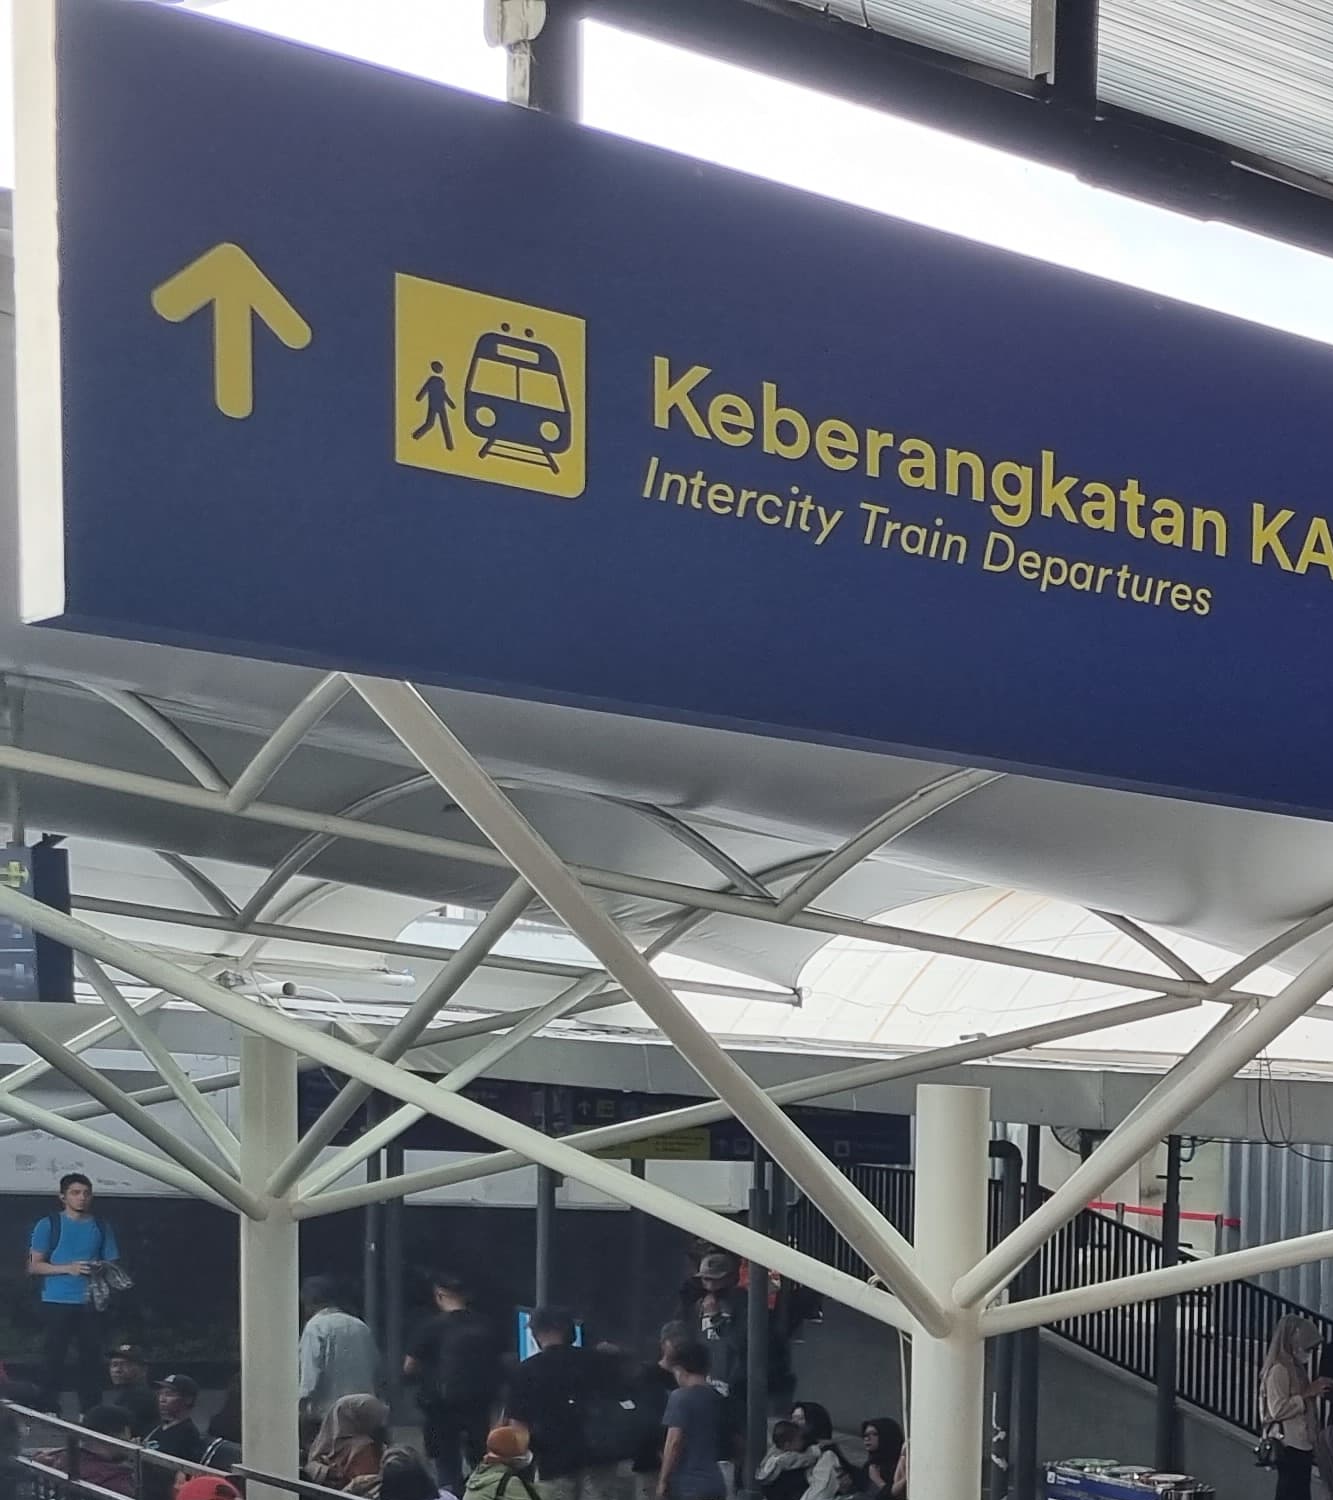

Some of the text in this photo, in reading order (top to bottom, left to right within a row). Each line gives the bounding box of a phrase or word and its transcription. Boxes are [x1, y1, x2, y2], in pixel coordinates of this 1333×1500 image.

[641, 456, 1213, 617] Intercity Train Departures
[652, 355, 1228, 557] Keberangkatan
